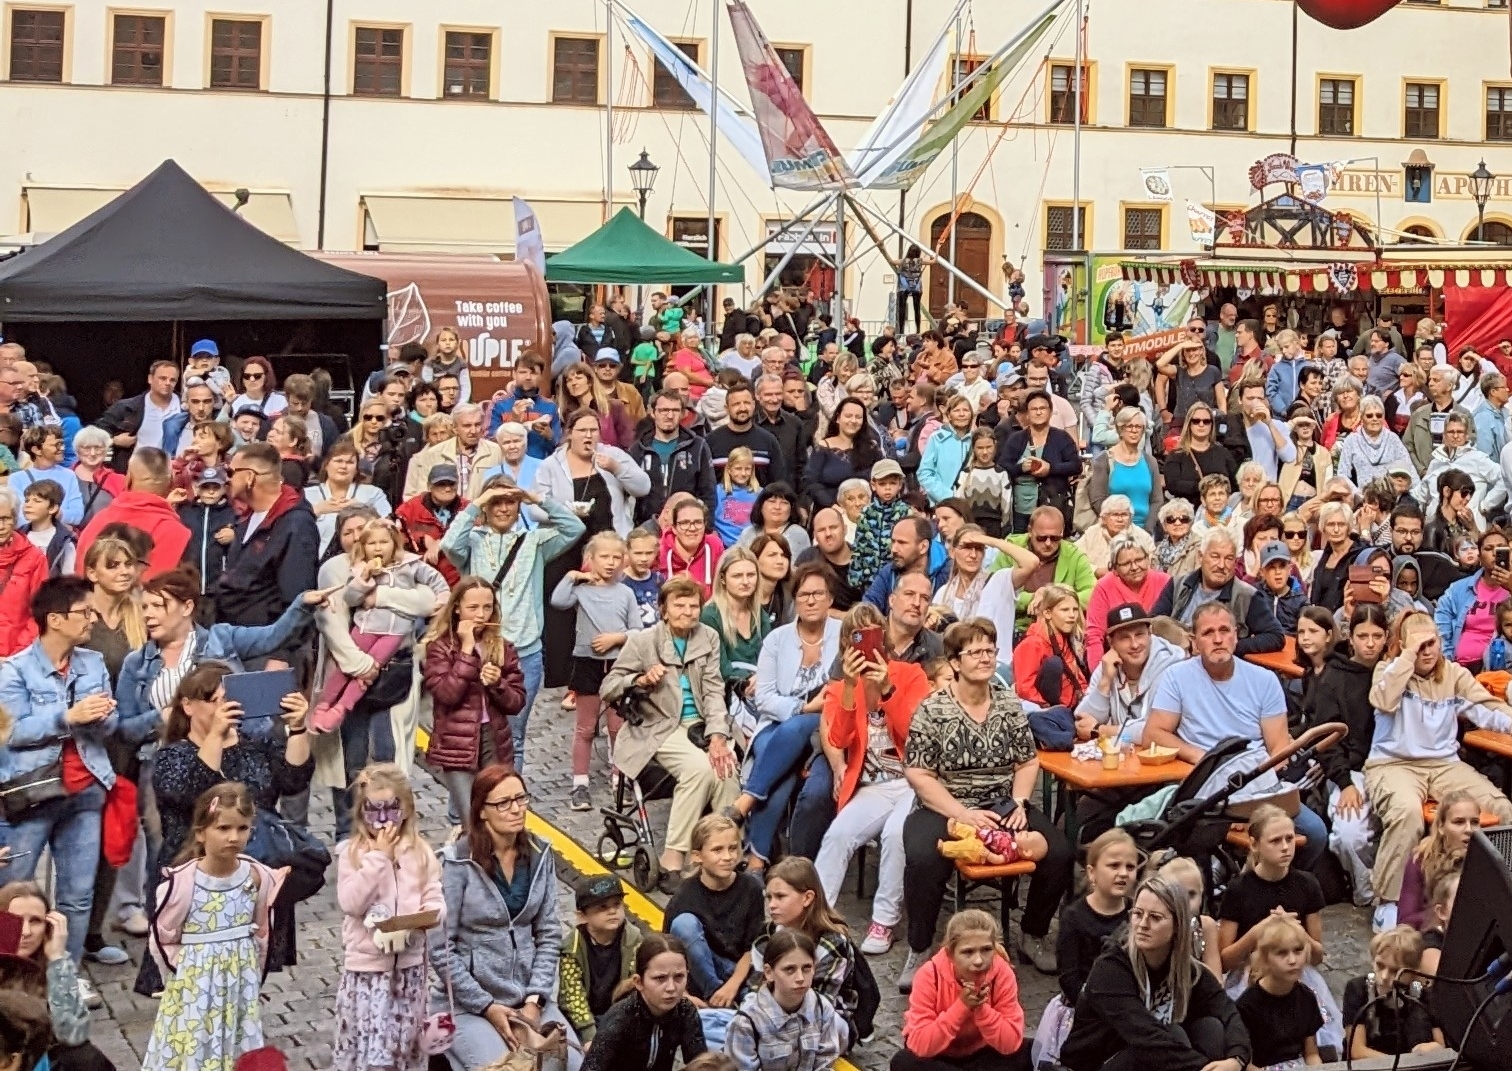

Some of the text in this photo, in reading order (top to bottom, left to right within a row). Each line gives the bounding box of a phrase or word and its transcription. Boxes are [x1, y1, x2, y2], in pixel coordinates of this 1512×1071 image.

[455, 300, 523, 314] Take coffee
[457, 314, 508, 331] with you
